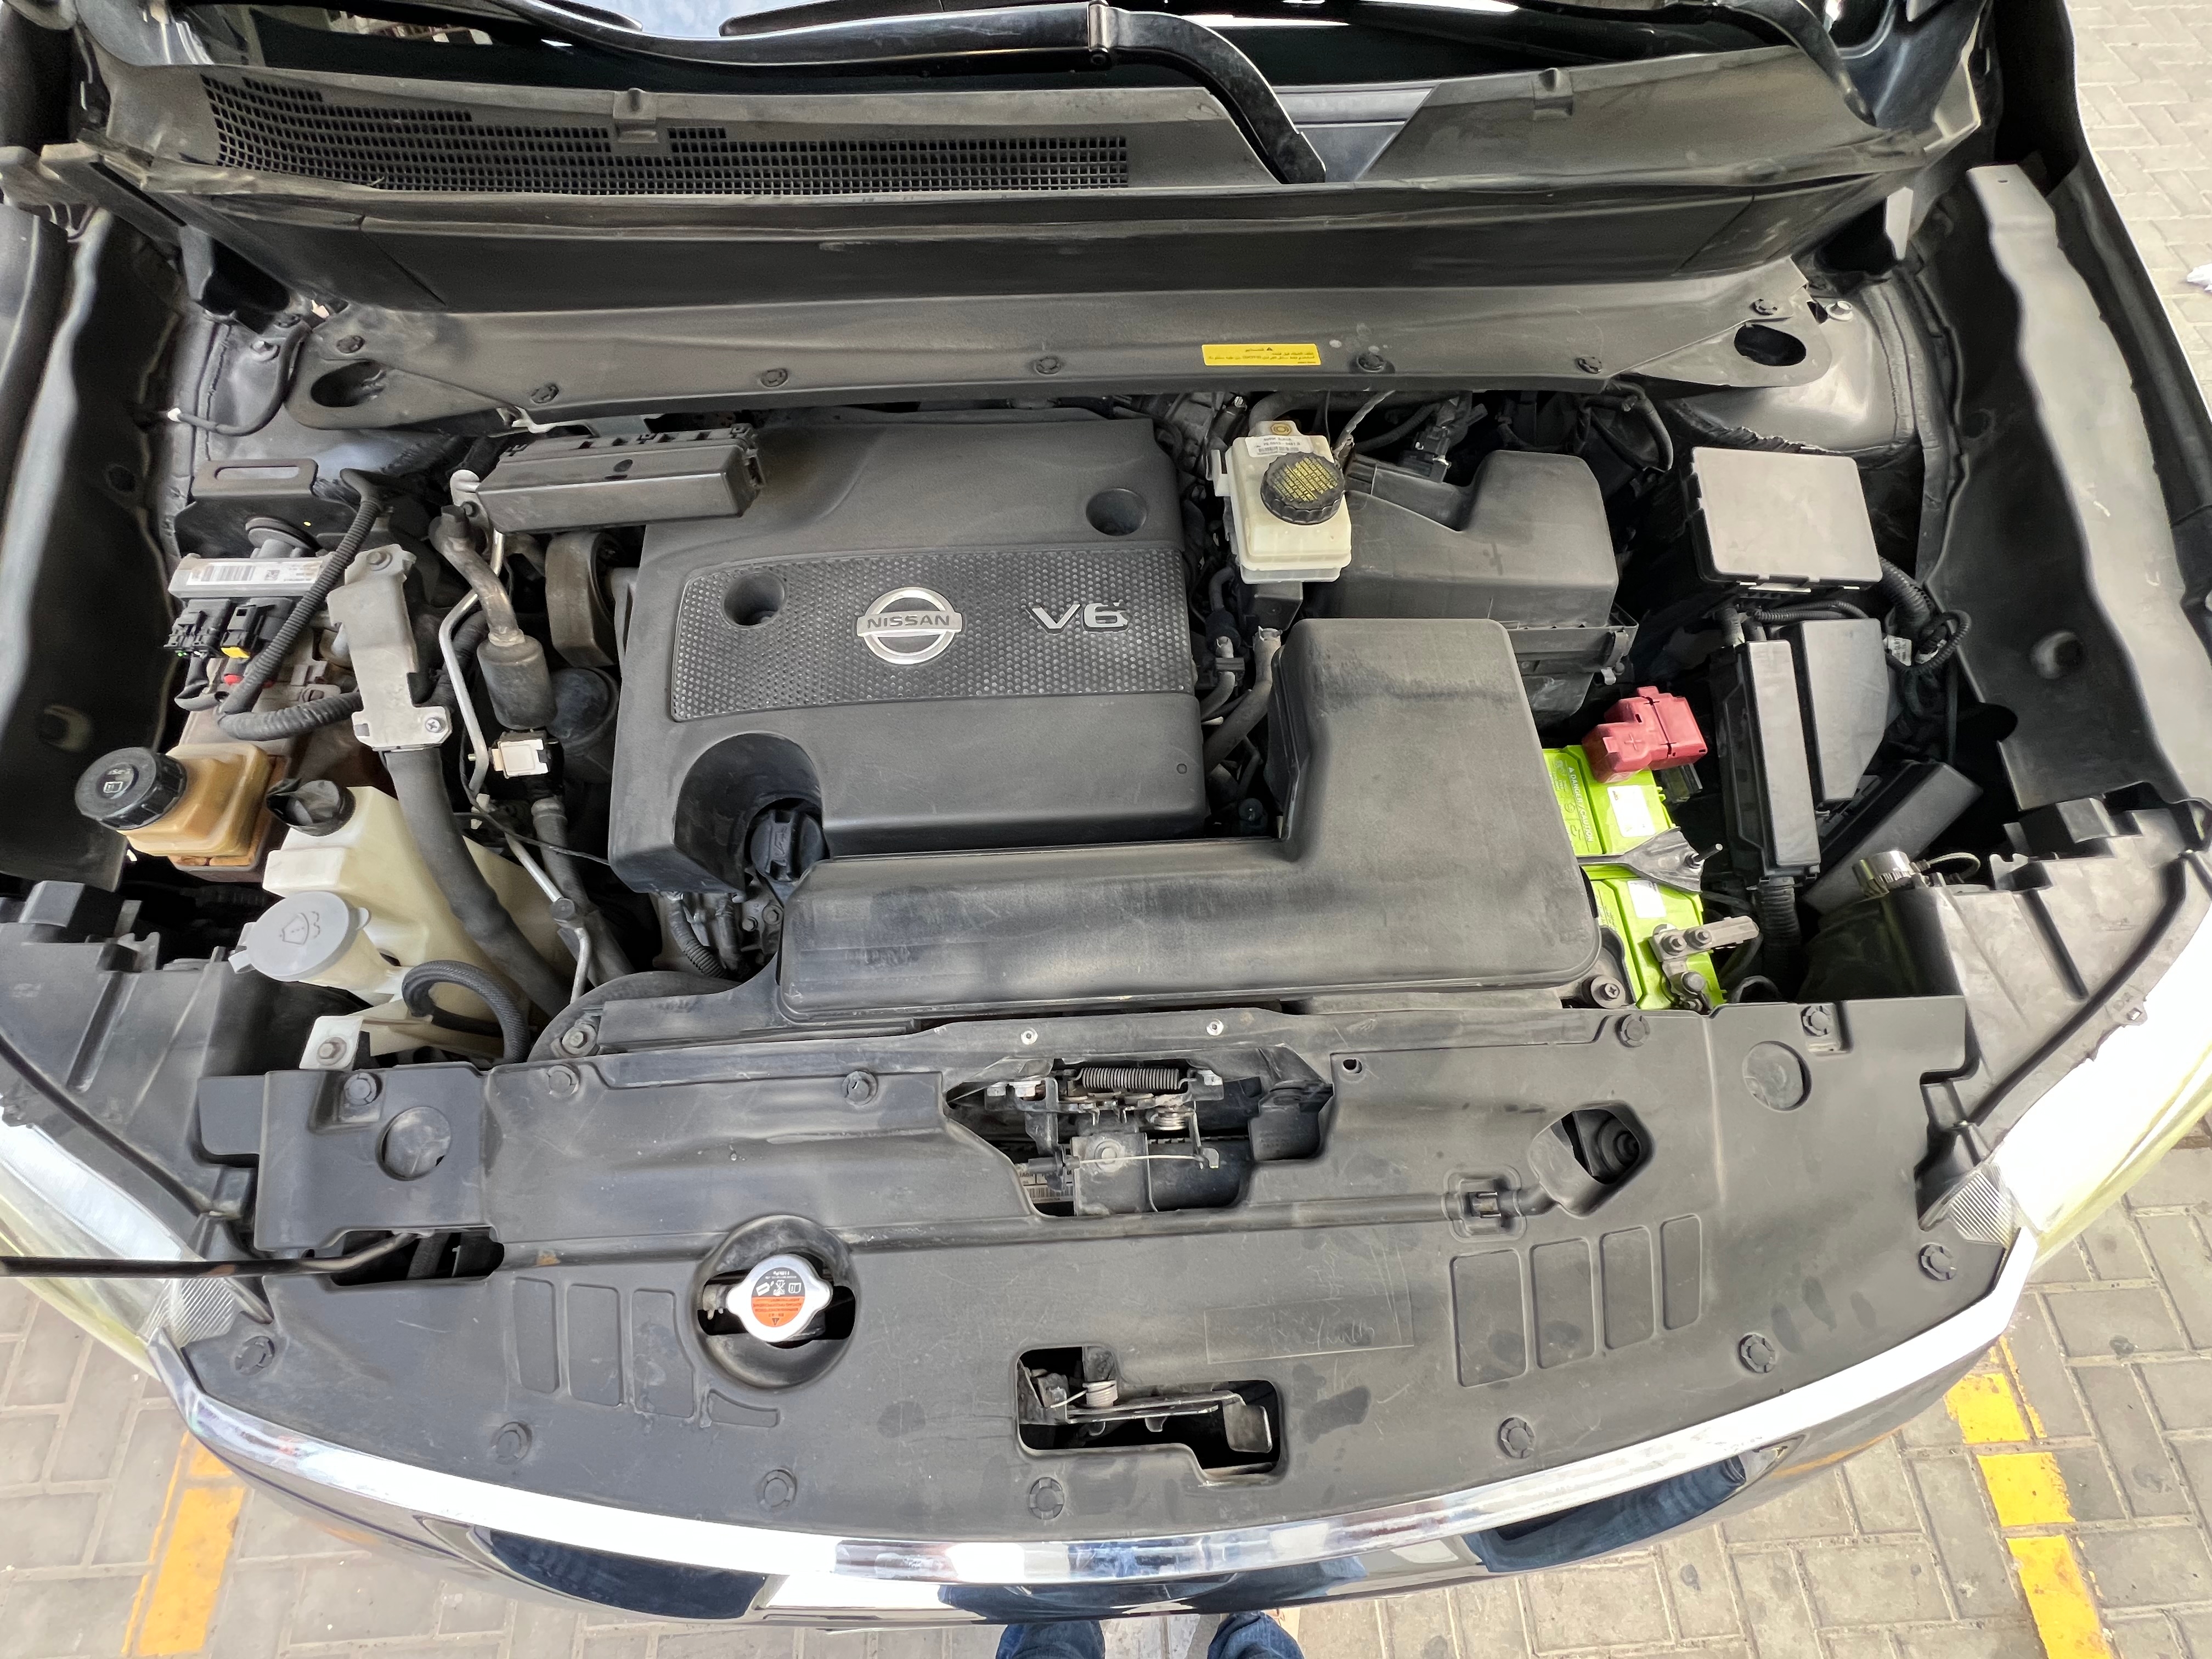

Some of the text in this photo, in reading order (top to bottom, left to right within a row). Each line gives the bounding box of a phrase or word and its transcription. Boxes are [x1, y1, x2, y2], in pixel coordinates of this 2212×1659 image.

[867, 614, 950, 629] NISSAN
[1031, 601, 1130, 633] V6
[1570, 774, 1583, 803] DANGER
[1579, 810, 1594, 843] CAUTION
